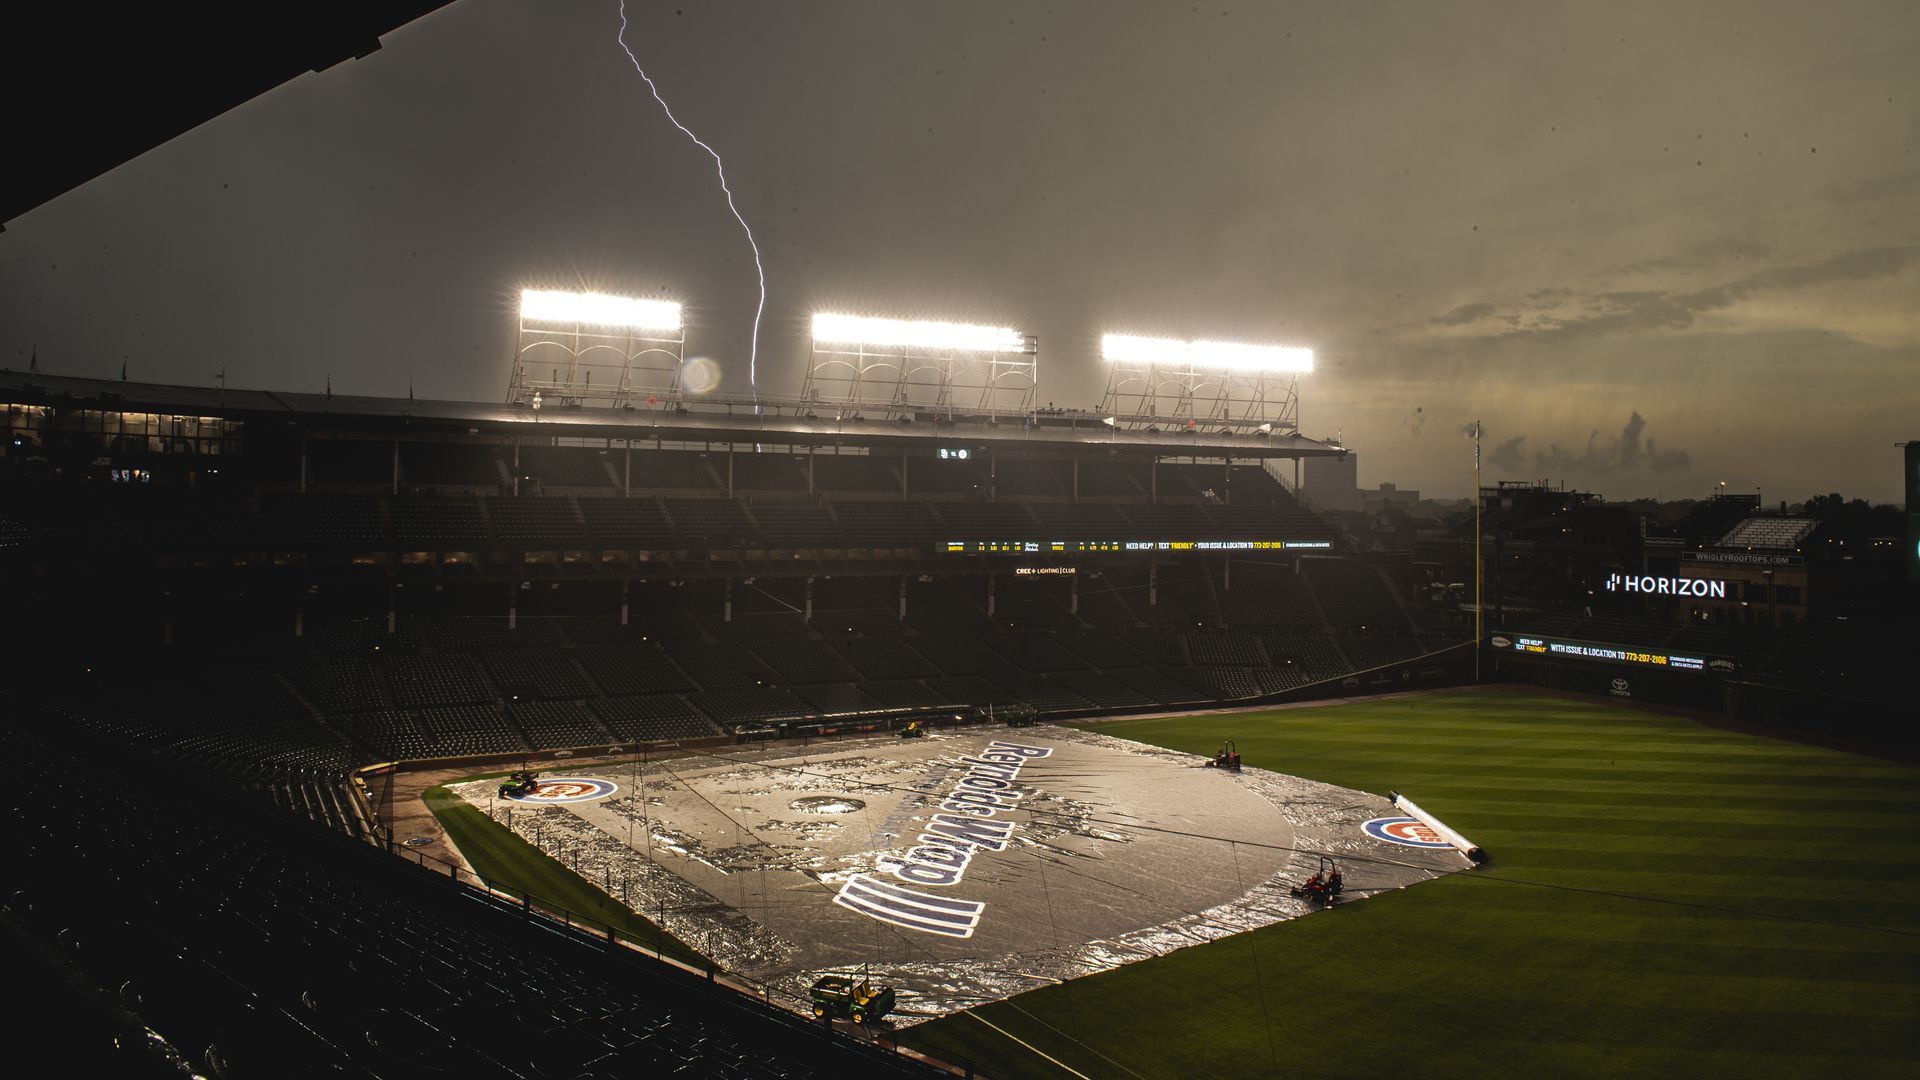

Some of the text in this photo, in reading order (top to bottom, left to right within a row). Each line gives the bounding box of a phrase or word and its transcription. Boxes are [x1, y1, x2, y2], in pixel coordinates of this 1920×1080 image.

[1625, 575, 1725, 598] HORIZON
[1550, 643, 1667, 664] WITH ISSUE & LOCATION TO 773-207-2106
[1610, 689, 1631, 697] TOYOTA
[939, 740, 1053, 817] Reynolds
[875, 813, 1016, 886] Wrap
